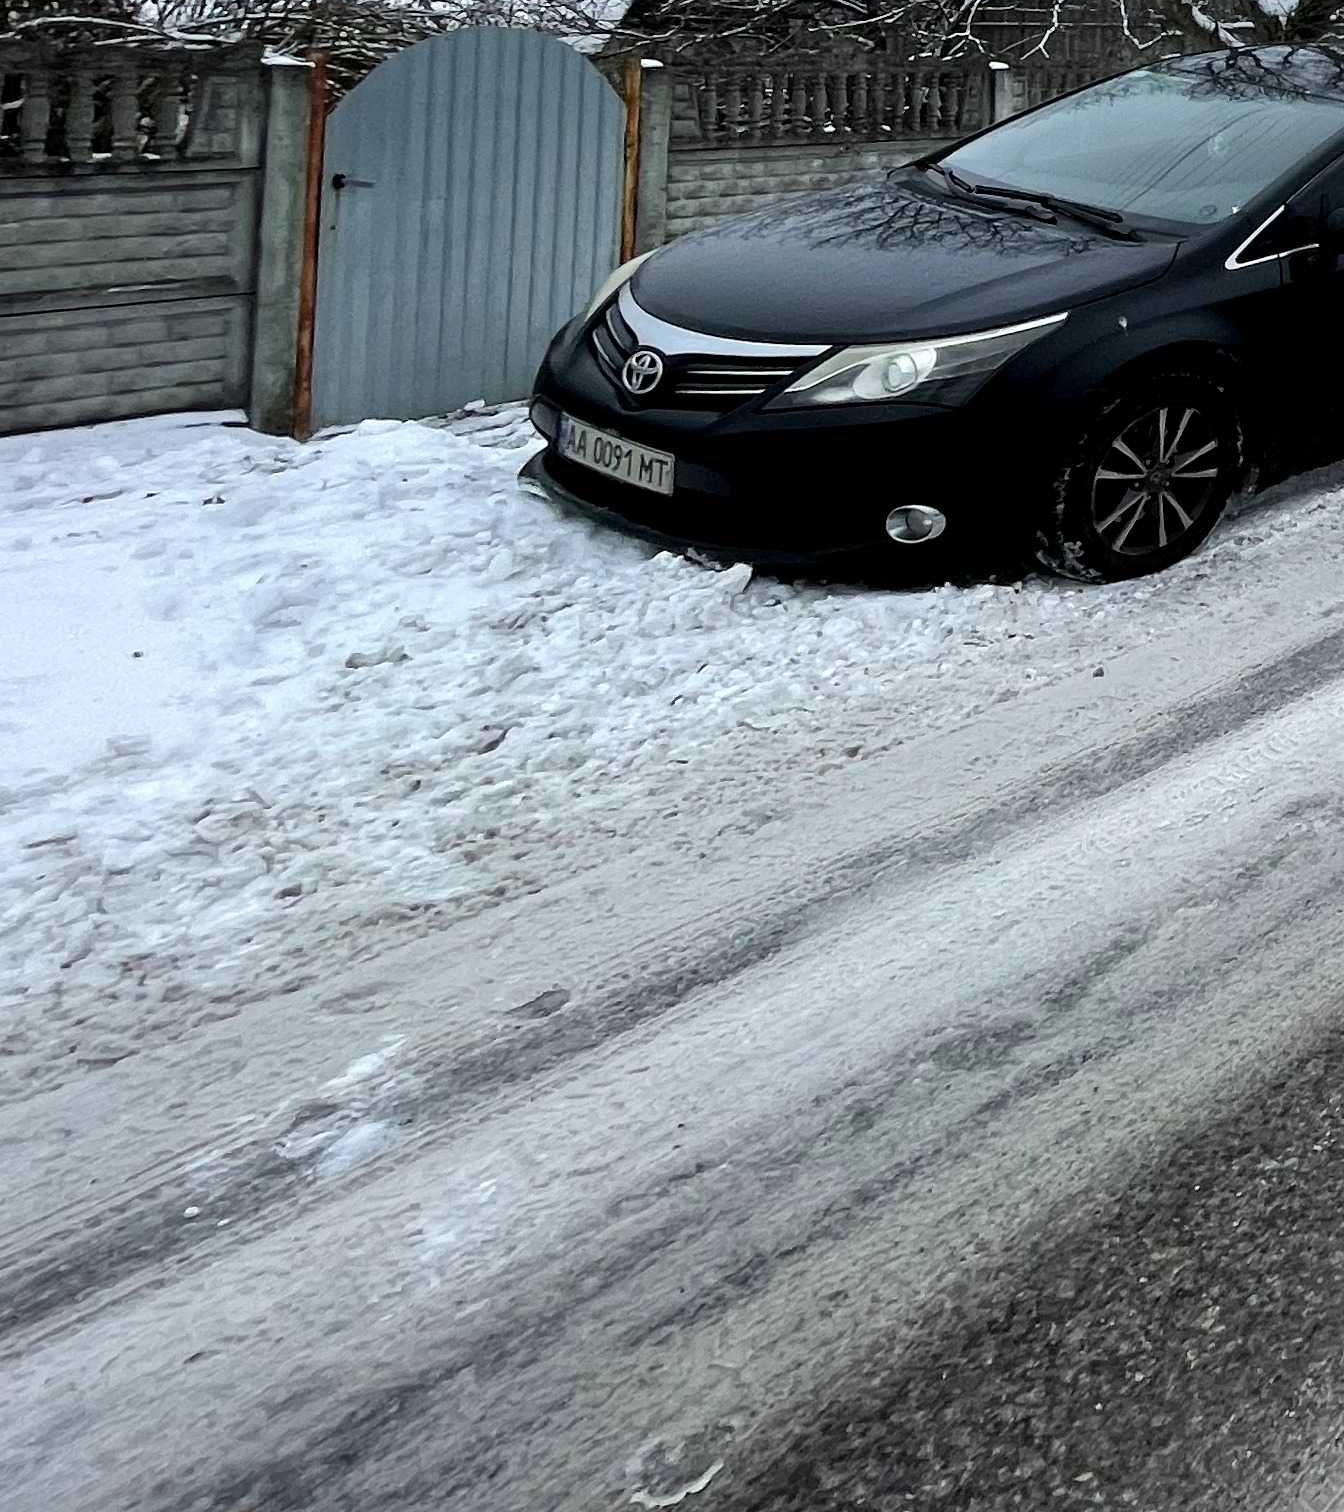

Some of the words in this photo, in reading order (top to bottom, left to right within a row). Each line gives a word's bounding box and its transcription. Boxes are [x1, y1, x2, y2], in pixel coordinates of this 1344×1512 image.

[567, 425, 587, 459] AA
[594, 437, 633, 476] 0091
[639, 454, 669, 486] MT
